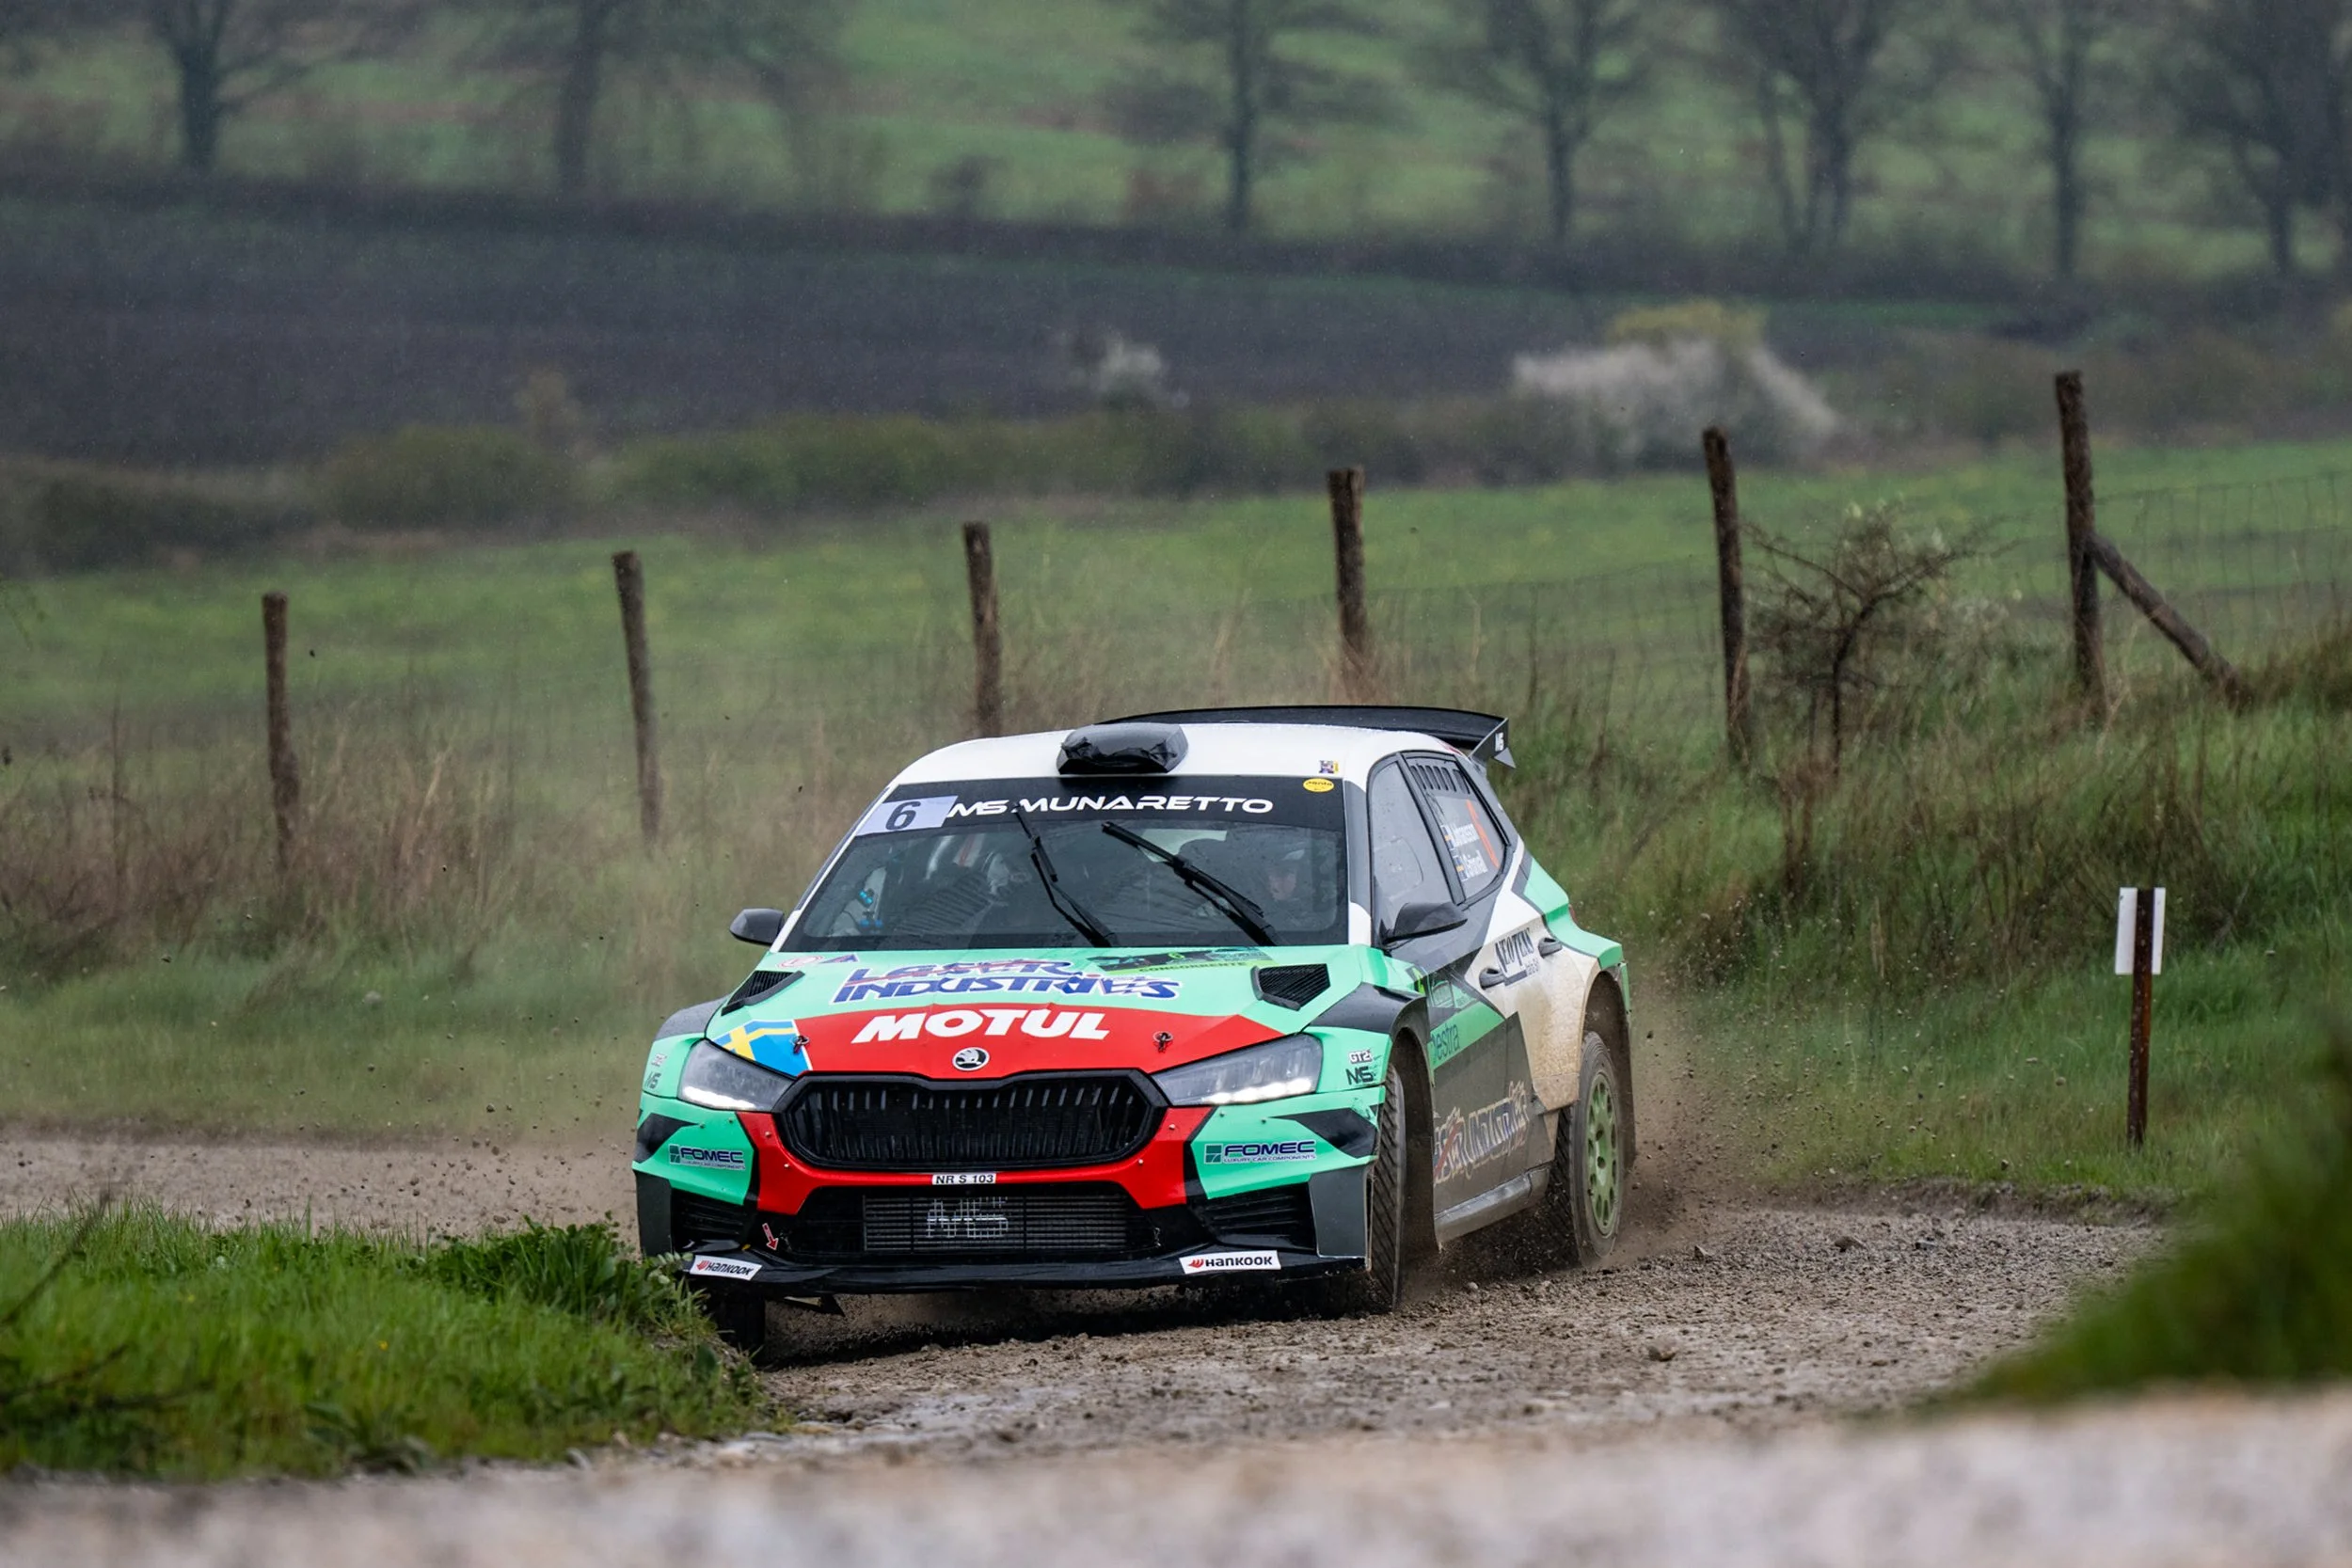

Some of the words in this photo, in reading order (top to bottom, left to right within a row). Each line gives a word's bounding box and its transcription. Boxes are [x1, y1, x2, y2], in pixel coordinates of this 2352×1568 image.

[1010, 797, 1274, 814] MUNARETTO
[885, 800, 921, 831] 6
[850, 1009, 1110, 1044] MOTUL
[680, 1147, 744, 1164] FOMEC
[1224, 1140, 1315, 1157] FOMEC
[935, 1175, 954, 1184] NR
[959, 1175, 967, 1183] S
[973, 1174, 994, 1183] 103
